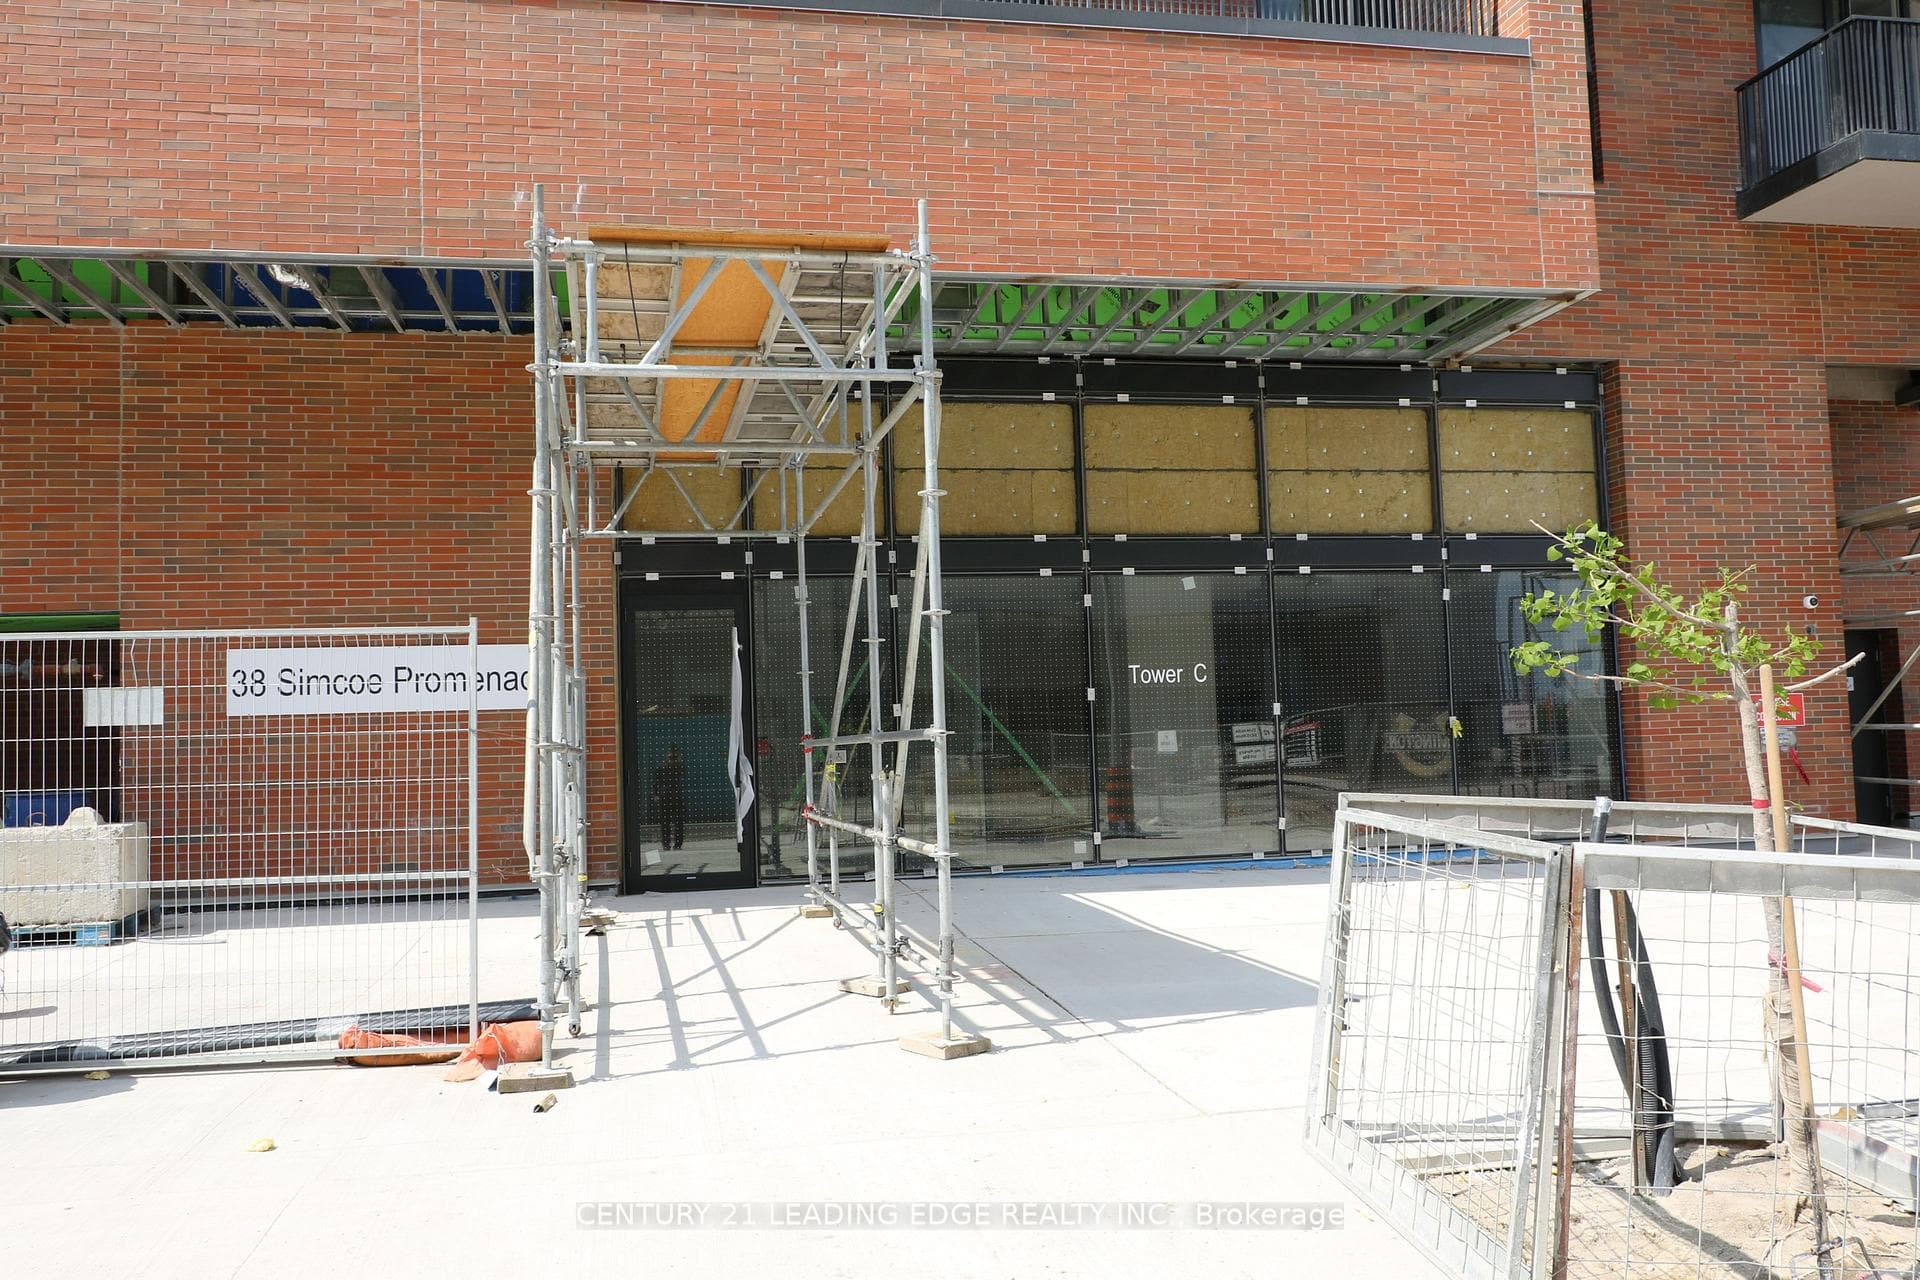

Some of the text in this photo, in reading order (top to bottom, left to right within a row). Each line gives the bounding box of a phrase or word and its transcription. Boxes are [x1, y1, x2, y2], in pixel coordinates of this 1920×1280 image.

[231, 668, 267, 698] 38
[277, 667, 383, 697] Simcoe
[1127, 663, 1208, 684] Tower C
